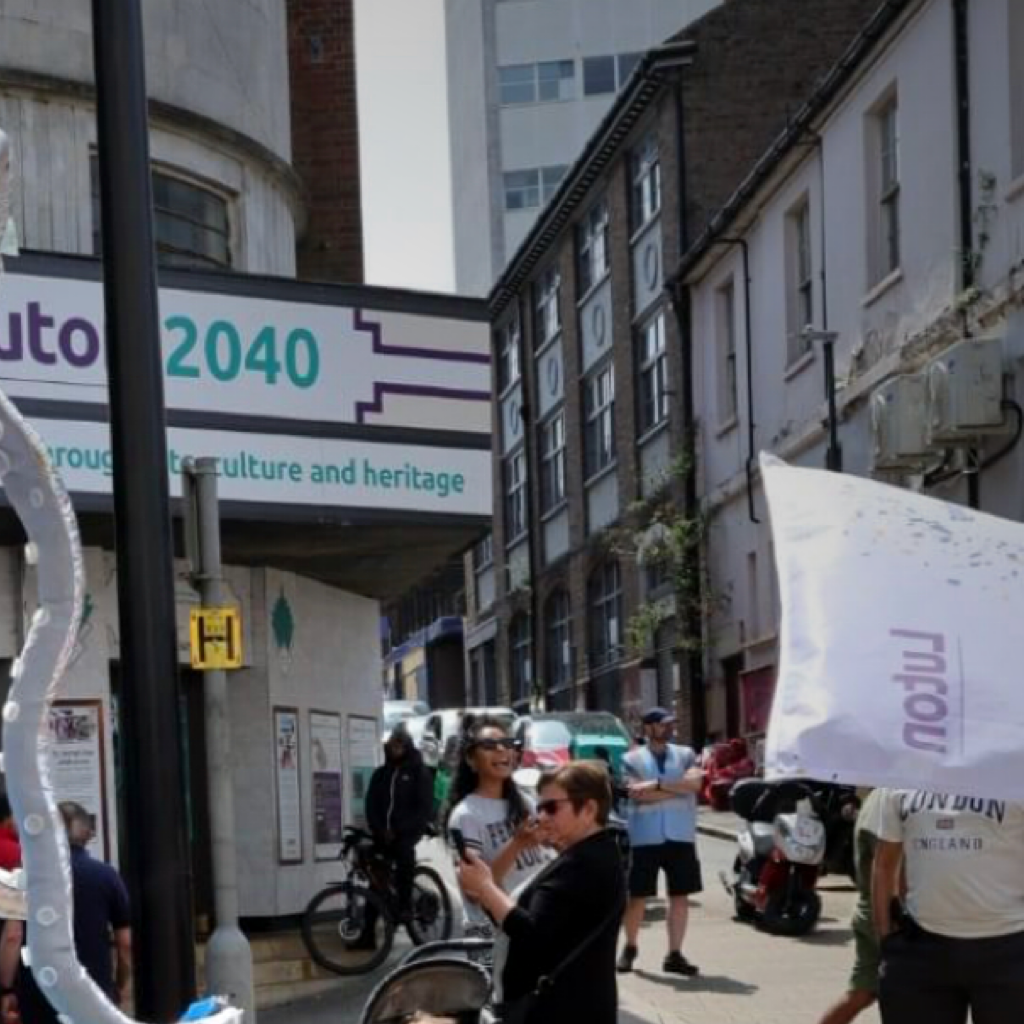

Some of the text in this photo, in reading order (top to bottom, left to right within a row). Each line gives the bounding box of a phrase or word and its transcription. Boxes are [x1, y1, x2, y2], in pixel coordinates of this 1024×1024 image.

[164, 316, 320, 388] 2040
[310, 458, 356, 485] and
[363, 459, 465, 498] heritage
[198, 615, 235, 662] H
